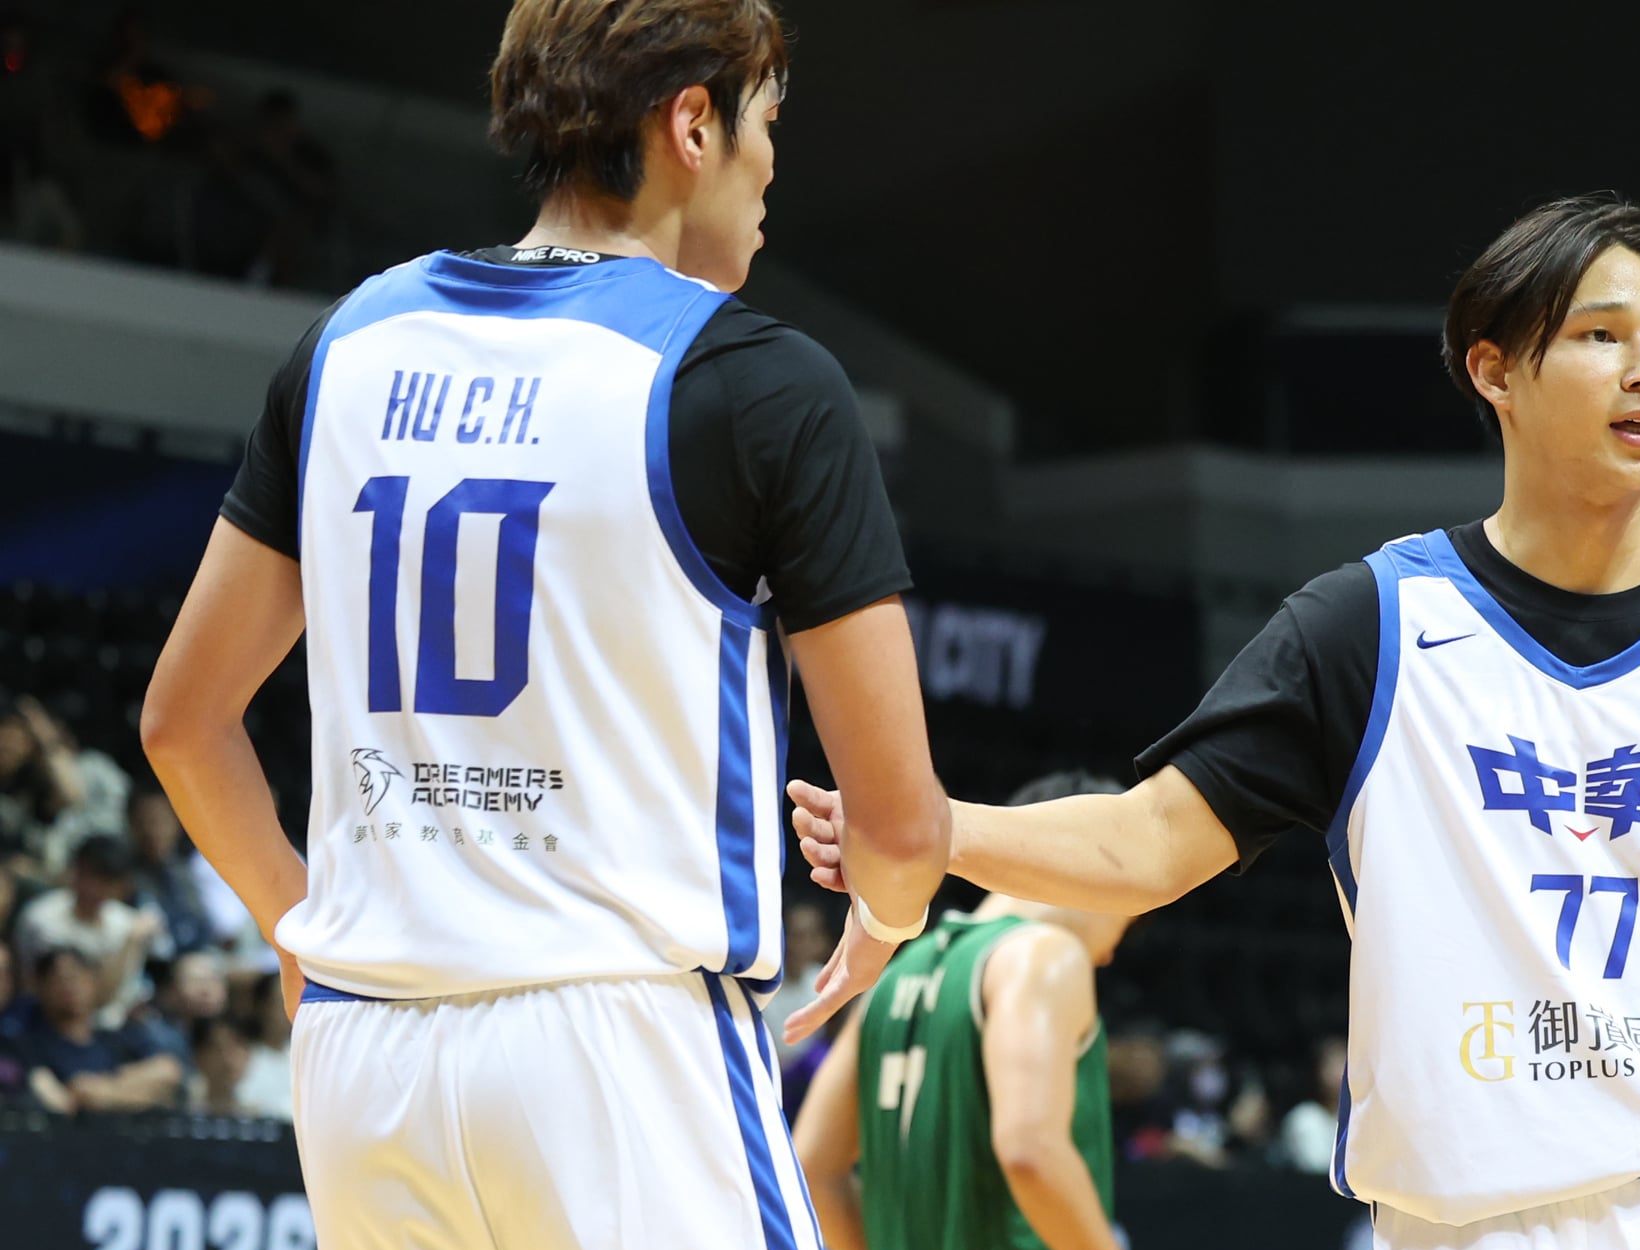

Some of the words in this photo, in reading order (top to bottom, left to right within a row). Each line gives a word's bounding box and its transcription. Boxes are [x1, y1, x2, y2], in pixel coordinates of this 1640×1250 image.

[511, 246, 549, 262] NIKE
[549, 247, 600, 264] PRO
[381, 370, 452, 442] HU
[456, 376, 542, 444] C.H.
[352, 475, 557, 717] 10
[411, 787, 544, 812] ACADEMY
[1530, 874, 1638, 979] 77
[1528, 1058, 1635, 1081] TOPLUS
